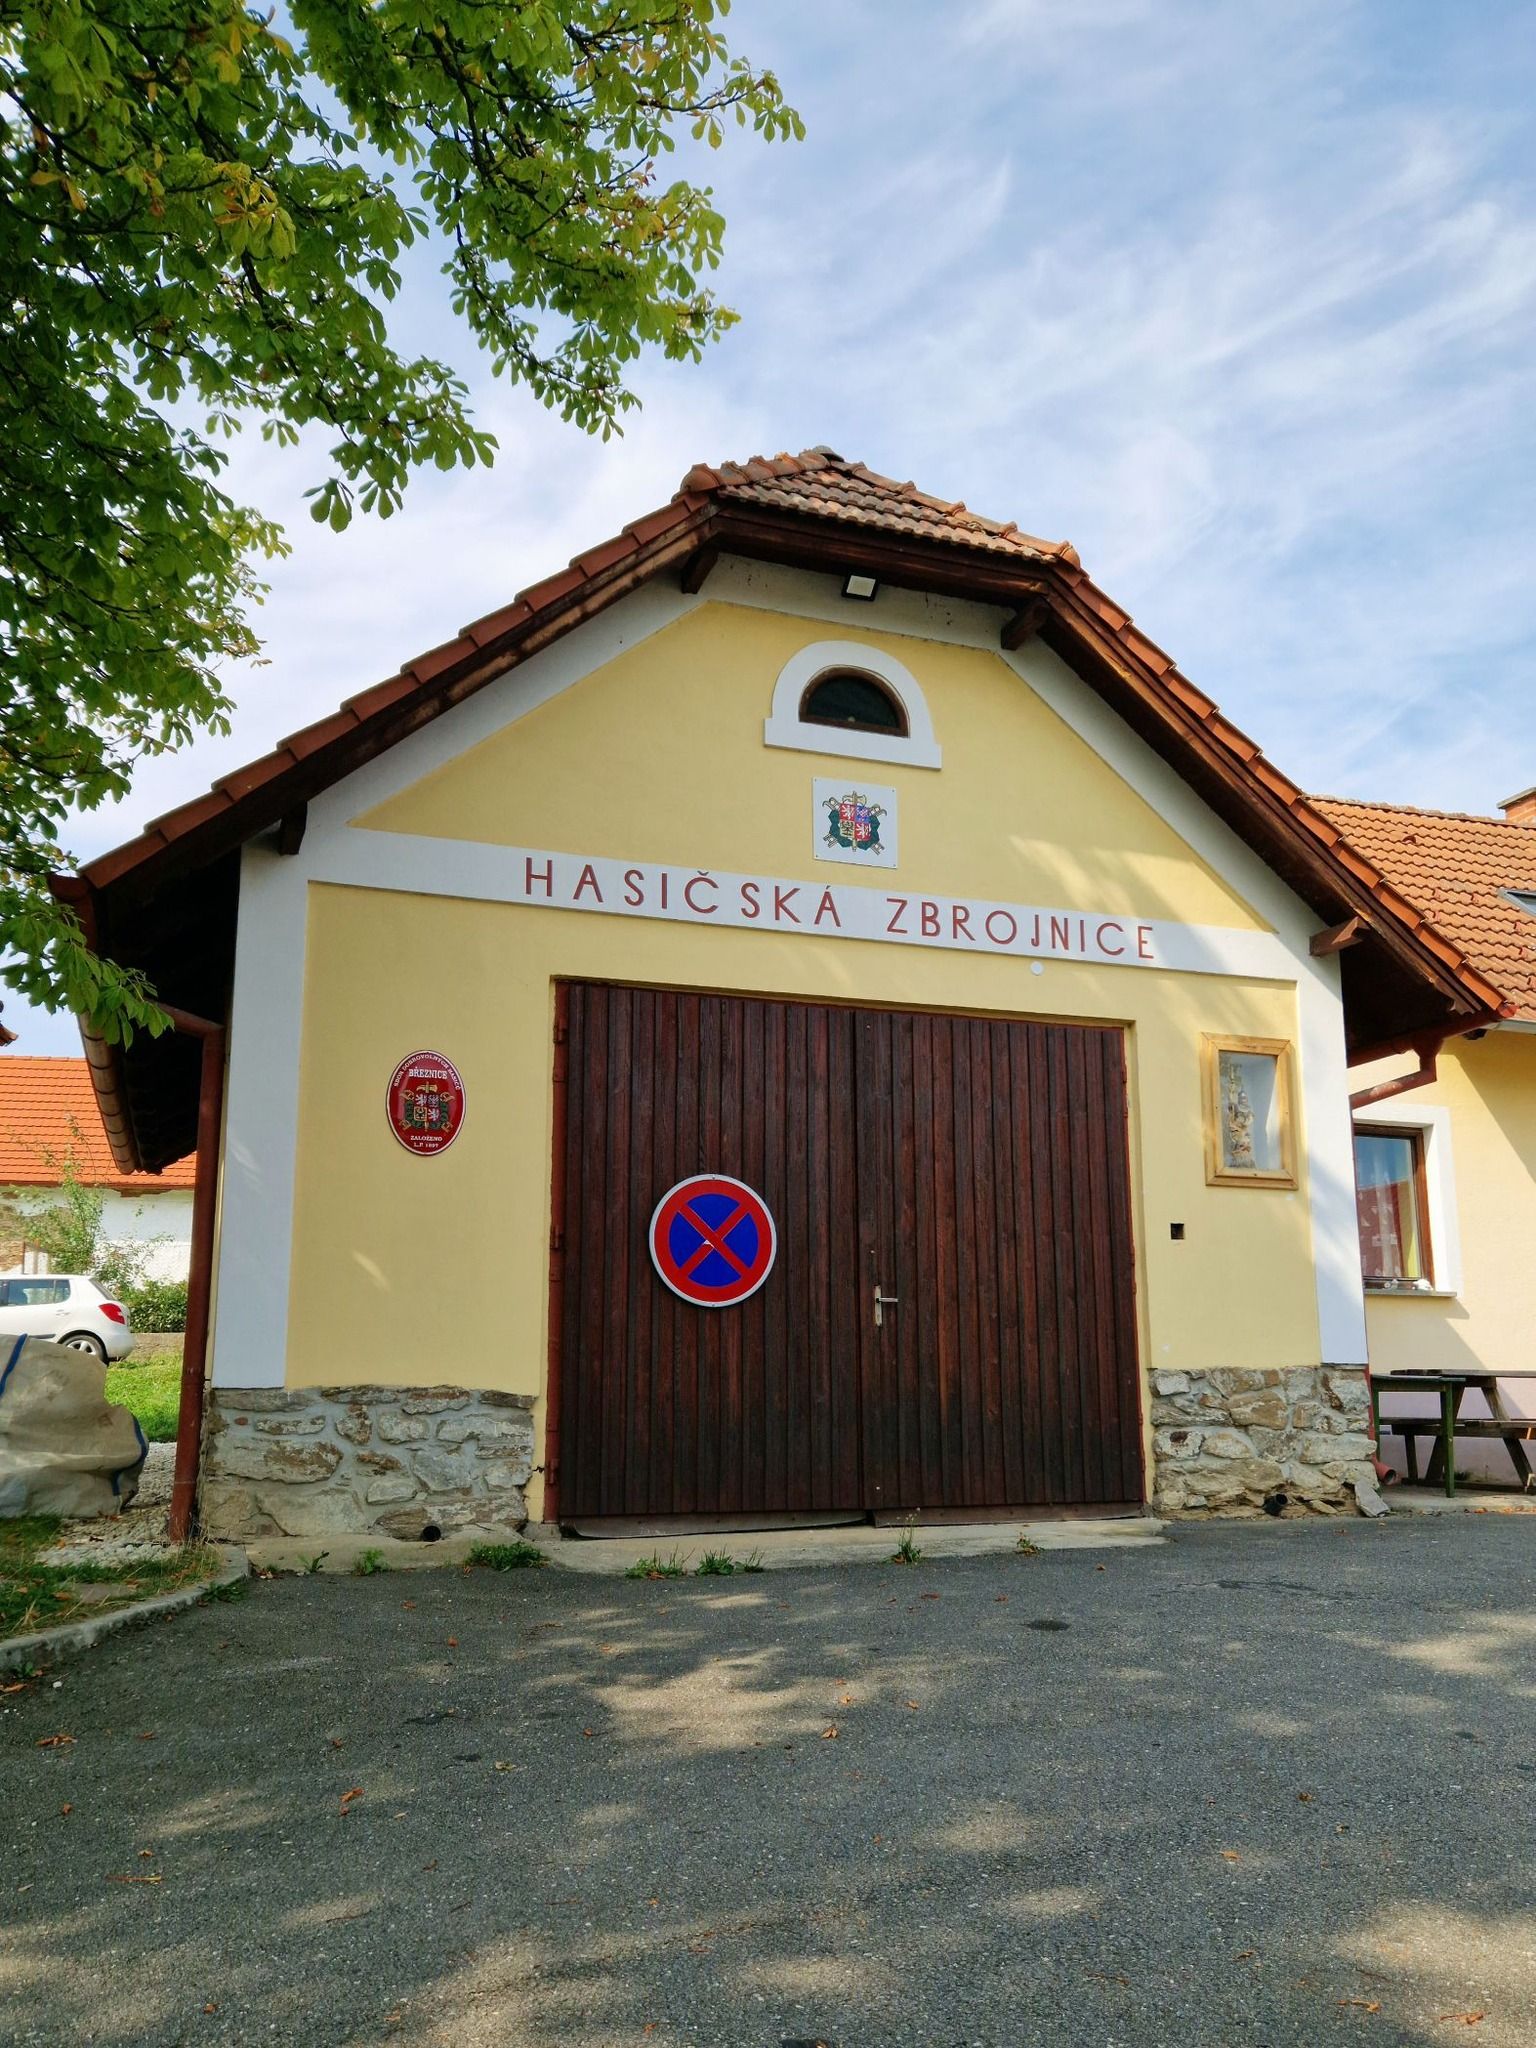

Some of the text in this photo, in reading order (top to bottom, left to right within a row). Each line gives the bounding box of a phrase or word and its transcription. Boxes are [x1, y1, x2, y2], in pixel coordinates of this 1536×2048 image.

[525, 857, 1155, 960] HASIČSKÁ ZBROJNICE
[408, 1066, 448, 1080] BŘEZNICE
